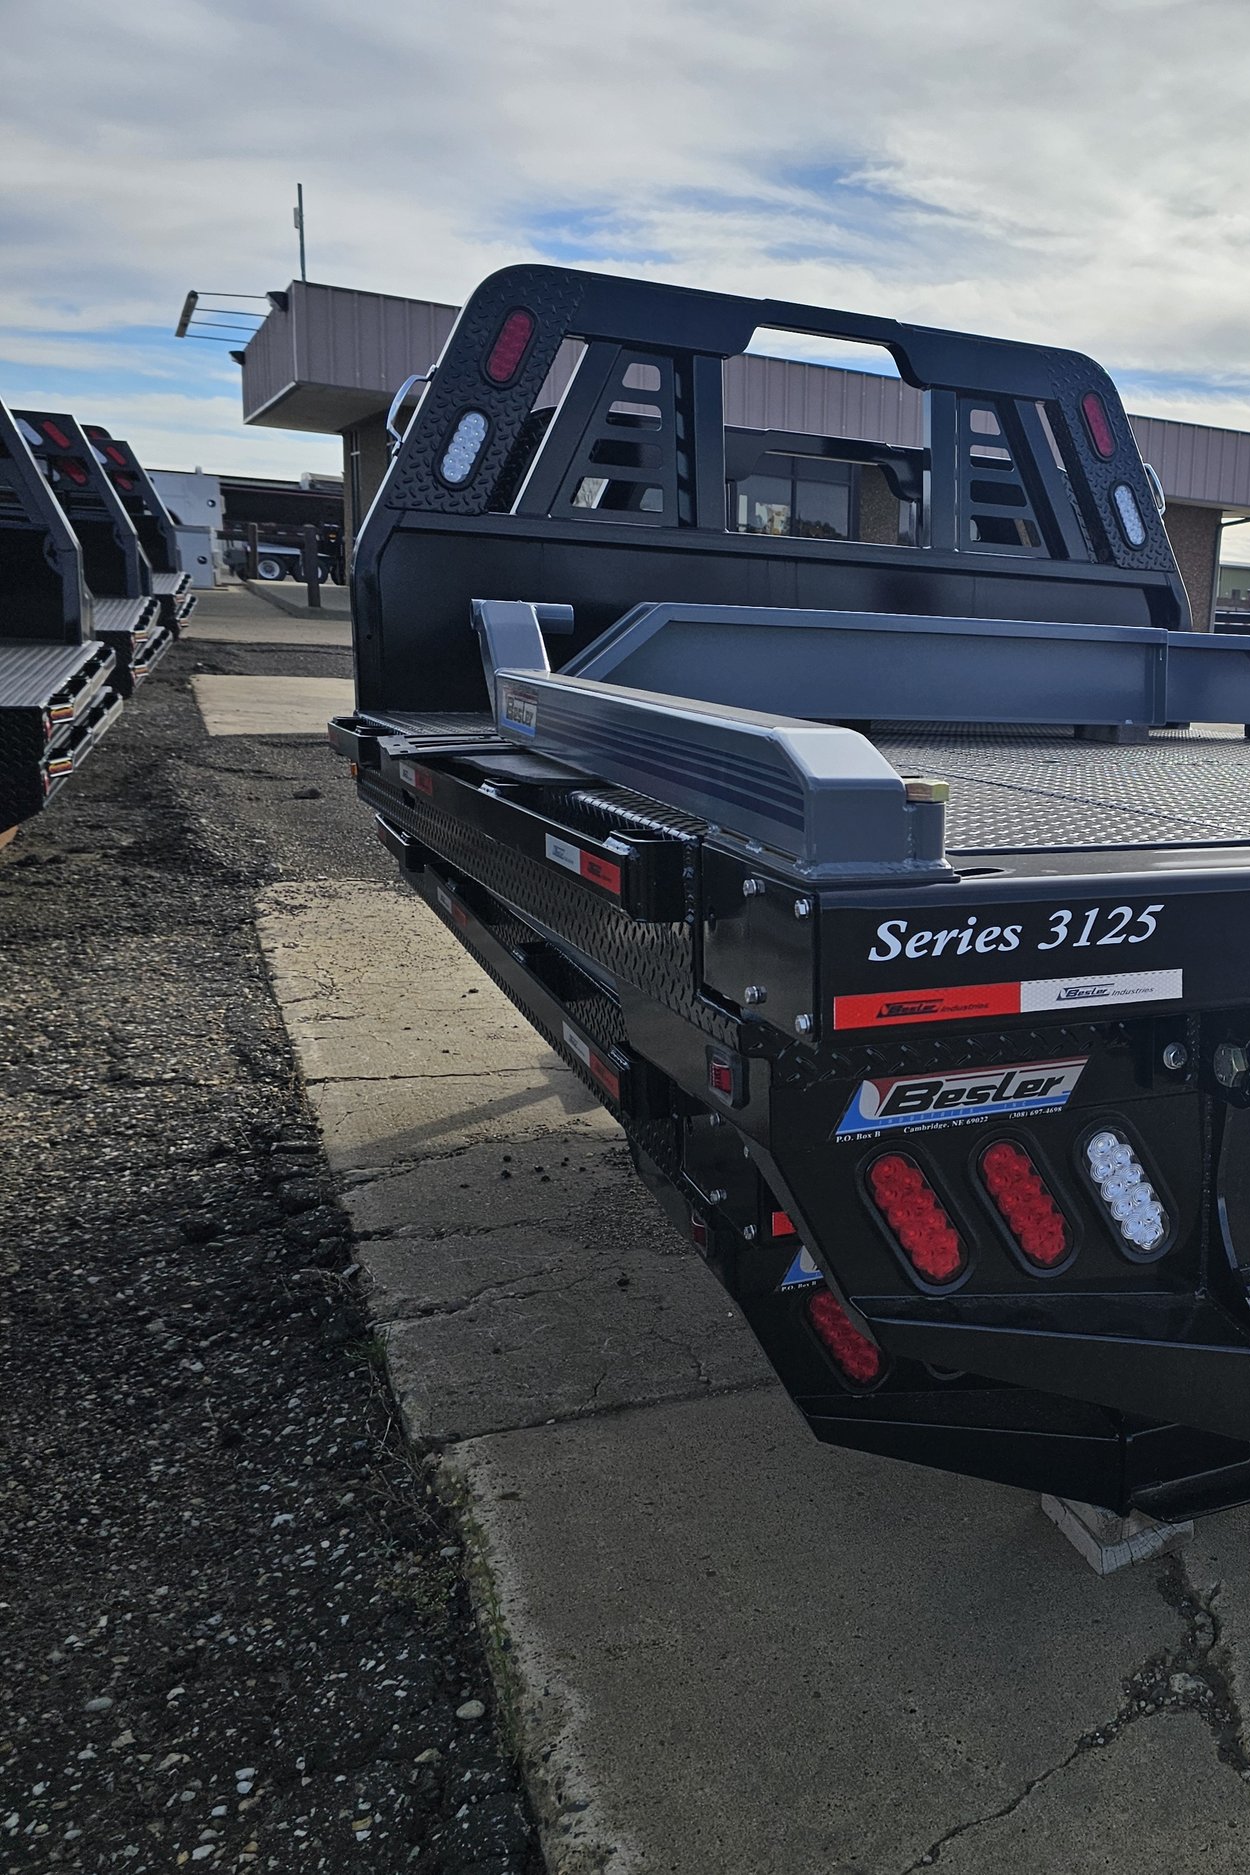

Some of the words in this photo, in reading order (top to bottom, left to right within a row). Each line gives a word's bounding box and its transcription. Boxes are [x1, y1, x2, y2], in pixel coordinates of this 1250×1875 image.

[868, 916, 1023, 962] Series
[1037, 904, 1165, 950] 3125
[1111, 987, 1155, 997] Industries
[878, 1070, 1065, 1118] Besler
[856, 1132, 872, 1140] Box
[952, 1118, 965, 1128] NE
[966, 1115, 989, 1126] 69022
